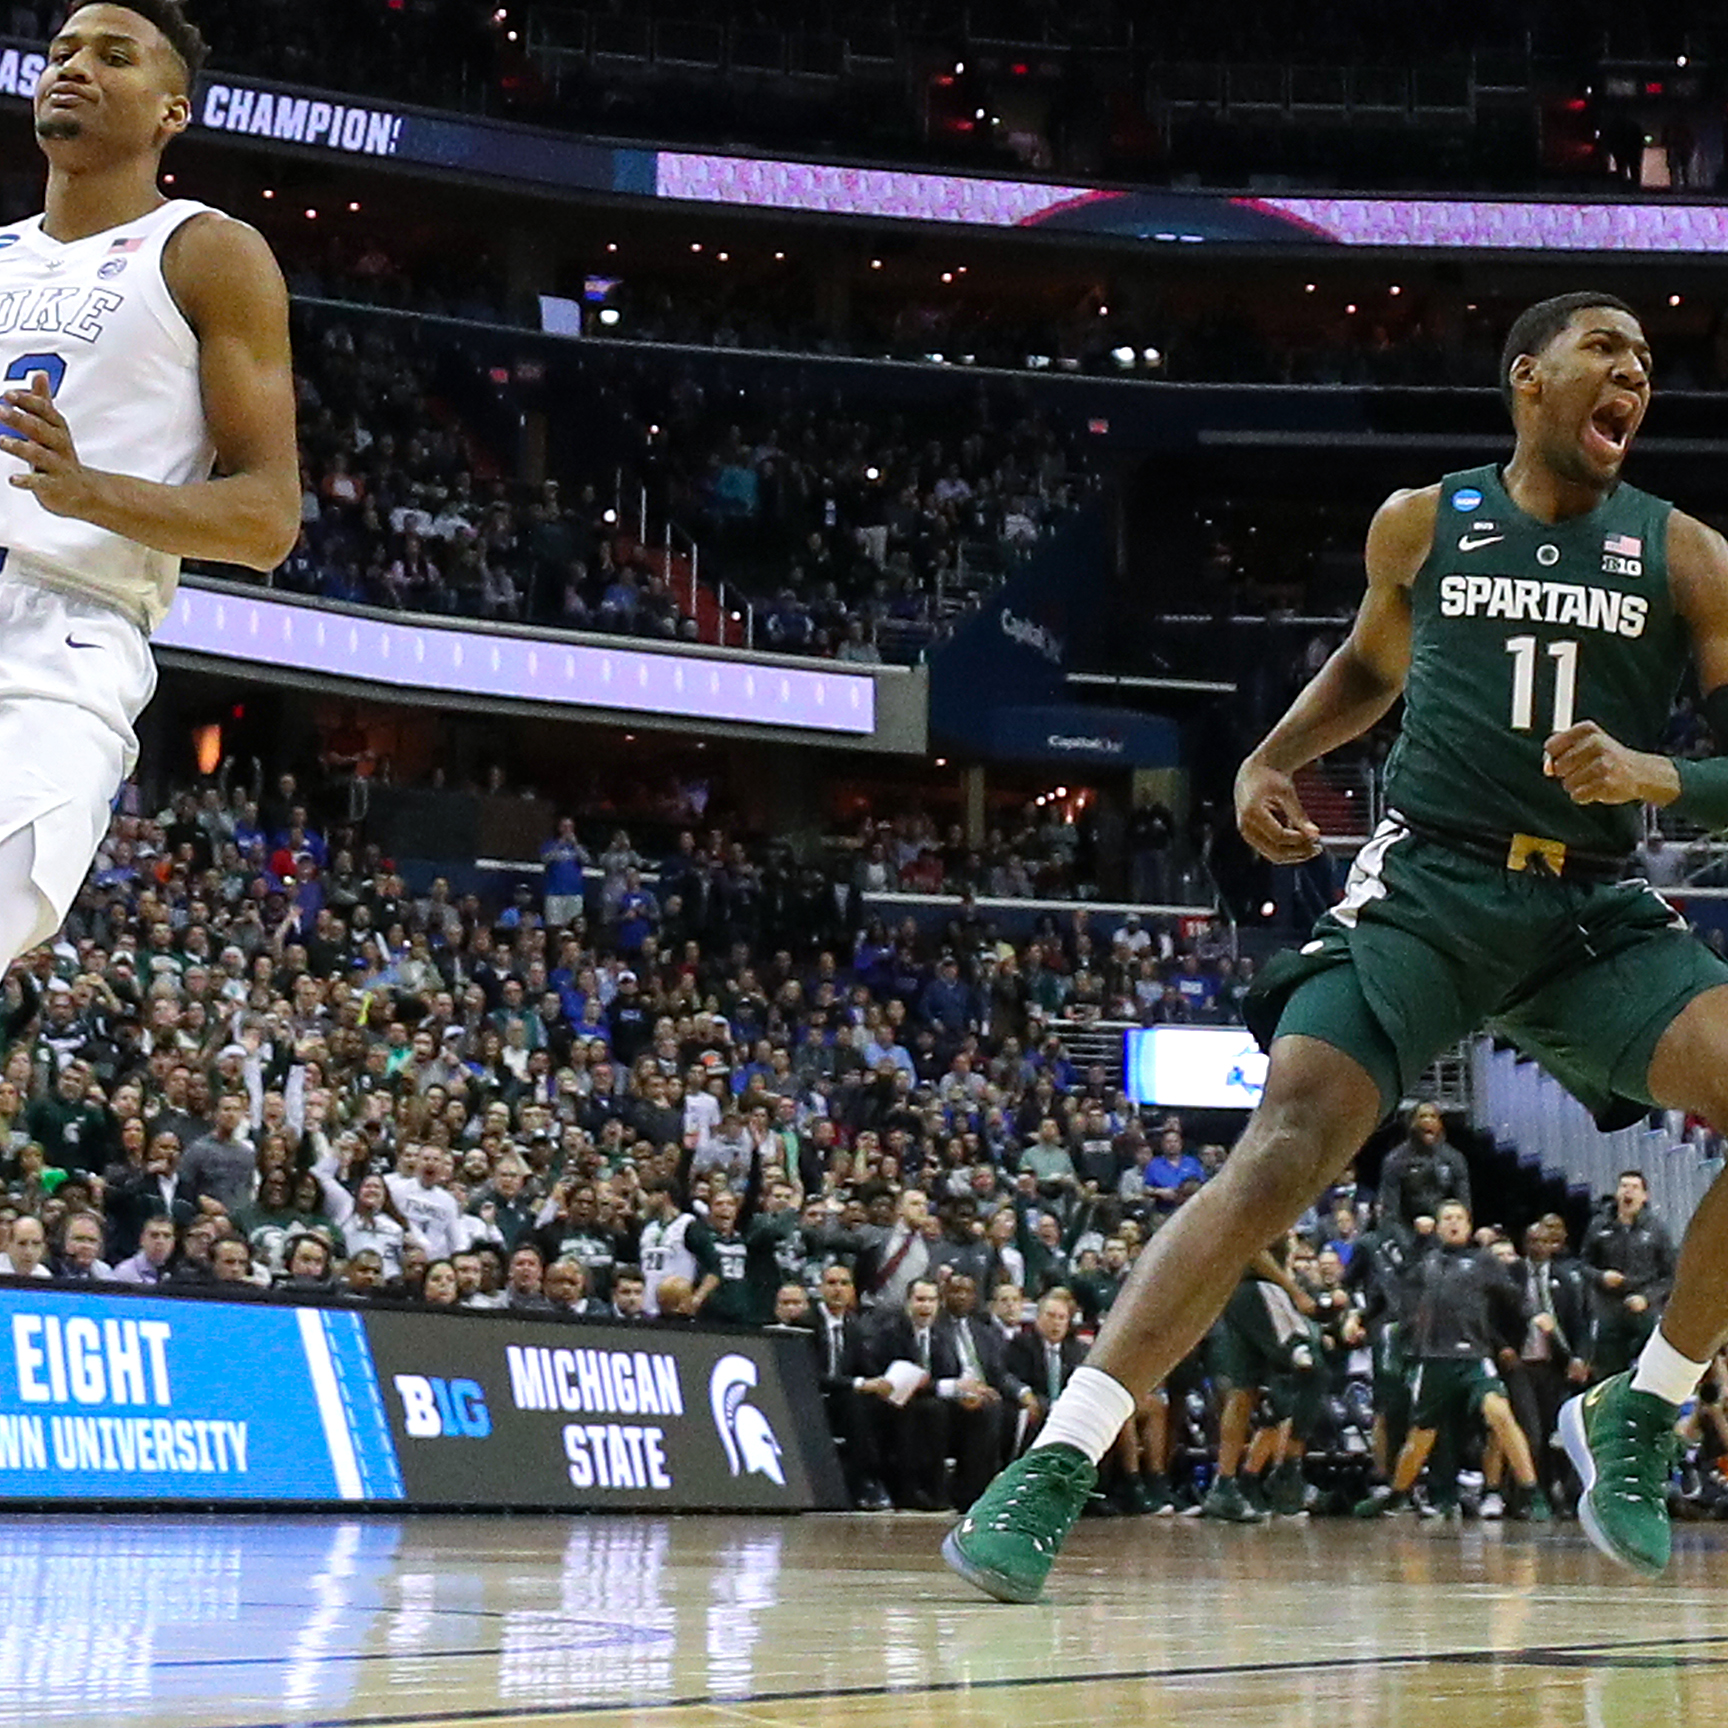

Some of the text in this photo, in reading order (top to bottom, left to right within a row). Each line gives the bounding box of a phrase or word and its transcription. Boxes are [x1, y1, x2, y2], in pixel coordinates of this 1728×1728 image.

[203, 84, 403, 156] CHAMPION
[1440, 575, 1649, 639] SPARTANS
[1504, 634, 1579, 734] 11
[11, 1313, 172, 1407] EIGHT
[505, 1345, 684, 1416] MICHIGAN
[51, 1418, 248, 1473] UNIVERSITY
[562, 1423, 672, 1490] STATE
